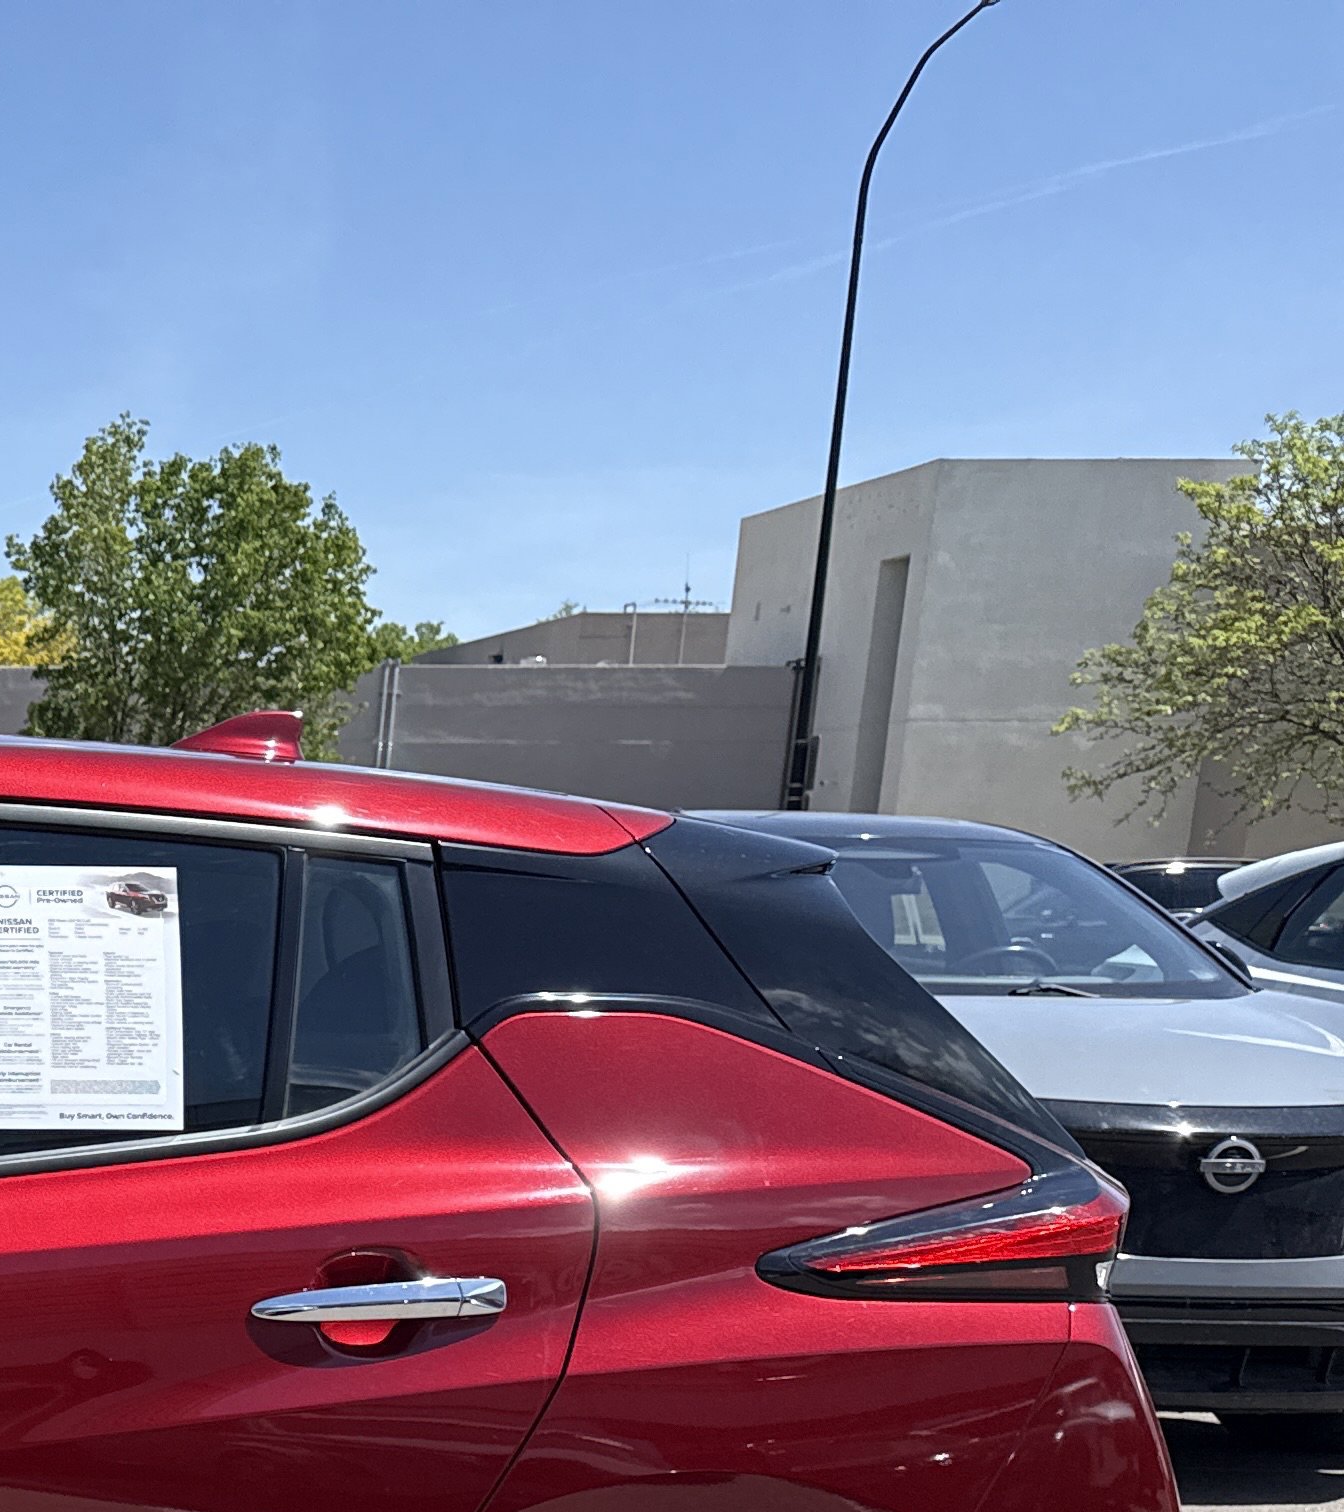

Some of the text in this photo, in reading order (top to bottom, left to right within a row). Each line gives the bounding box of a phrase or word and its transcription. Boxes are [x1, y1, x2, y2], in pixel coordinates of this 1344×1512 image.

[36, 889, 84, 897] CERTIFIED
[59, 1112, 75, 1121] Buy
[76, 1112, 105, 1121] Smart,
[105, 1112, 125, 1120] Own
[126, 1112, 175, 1120] Confidence.
